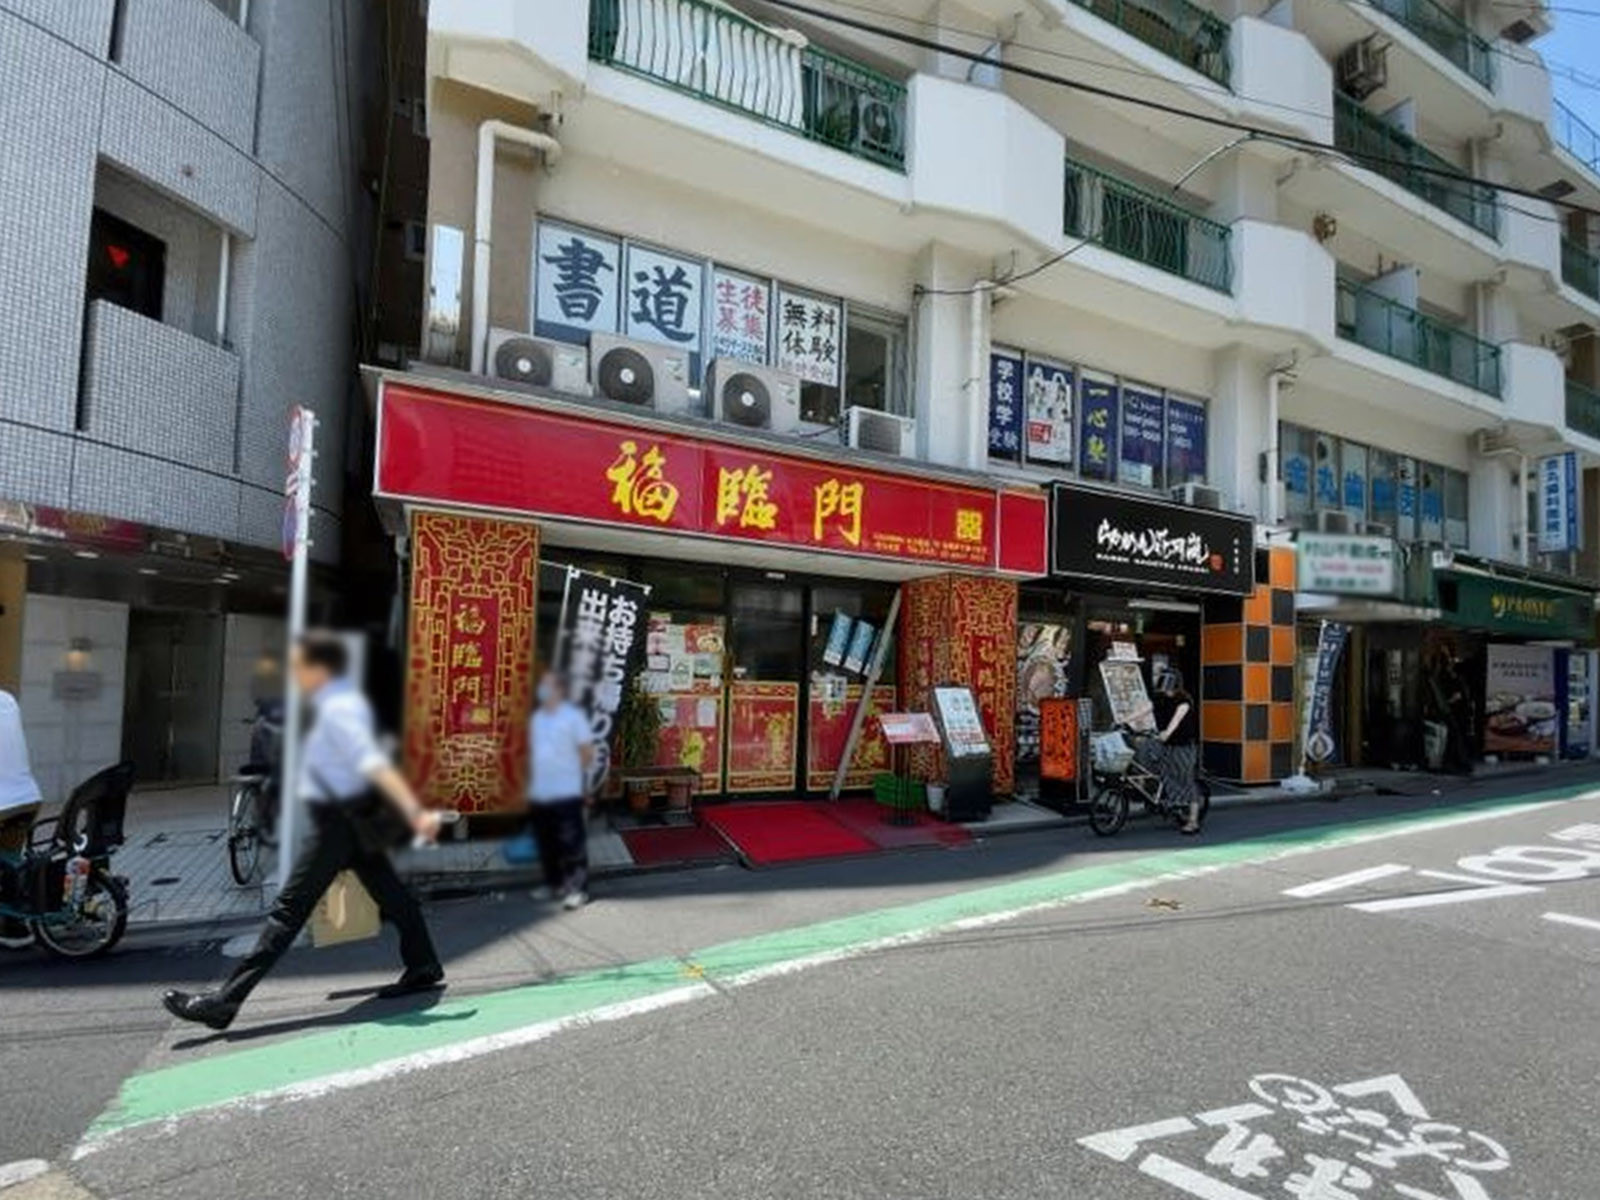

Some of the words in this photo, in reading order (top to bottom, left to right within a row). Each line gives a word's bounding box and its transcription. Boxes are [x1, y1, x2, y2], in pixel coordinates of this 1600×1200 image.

[544, 237, 694, 342] 書道
[717, 279, 765, 315] 生徒
[783, 298, 837, 337] 無料
[783, 330, 836, 364] 体験
[606, 440, 864, 547] 福臨門
[452, 602, 486, 703] 福臨門
[591, 594, 638, 738] お持ちり
